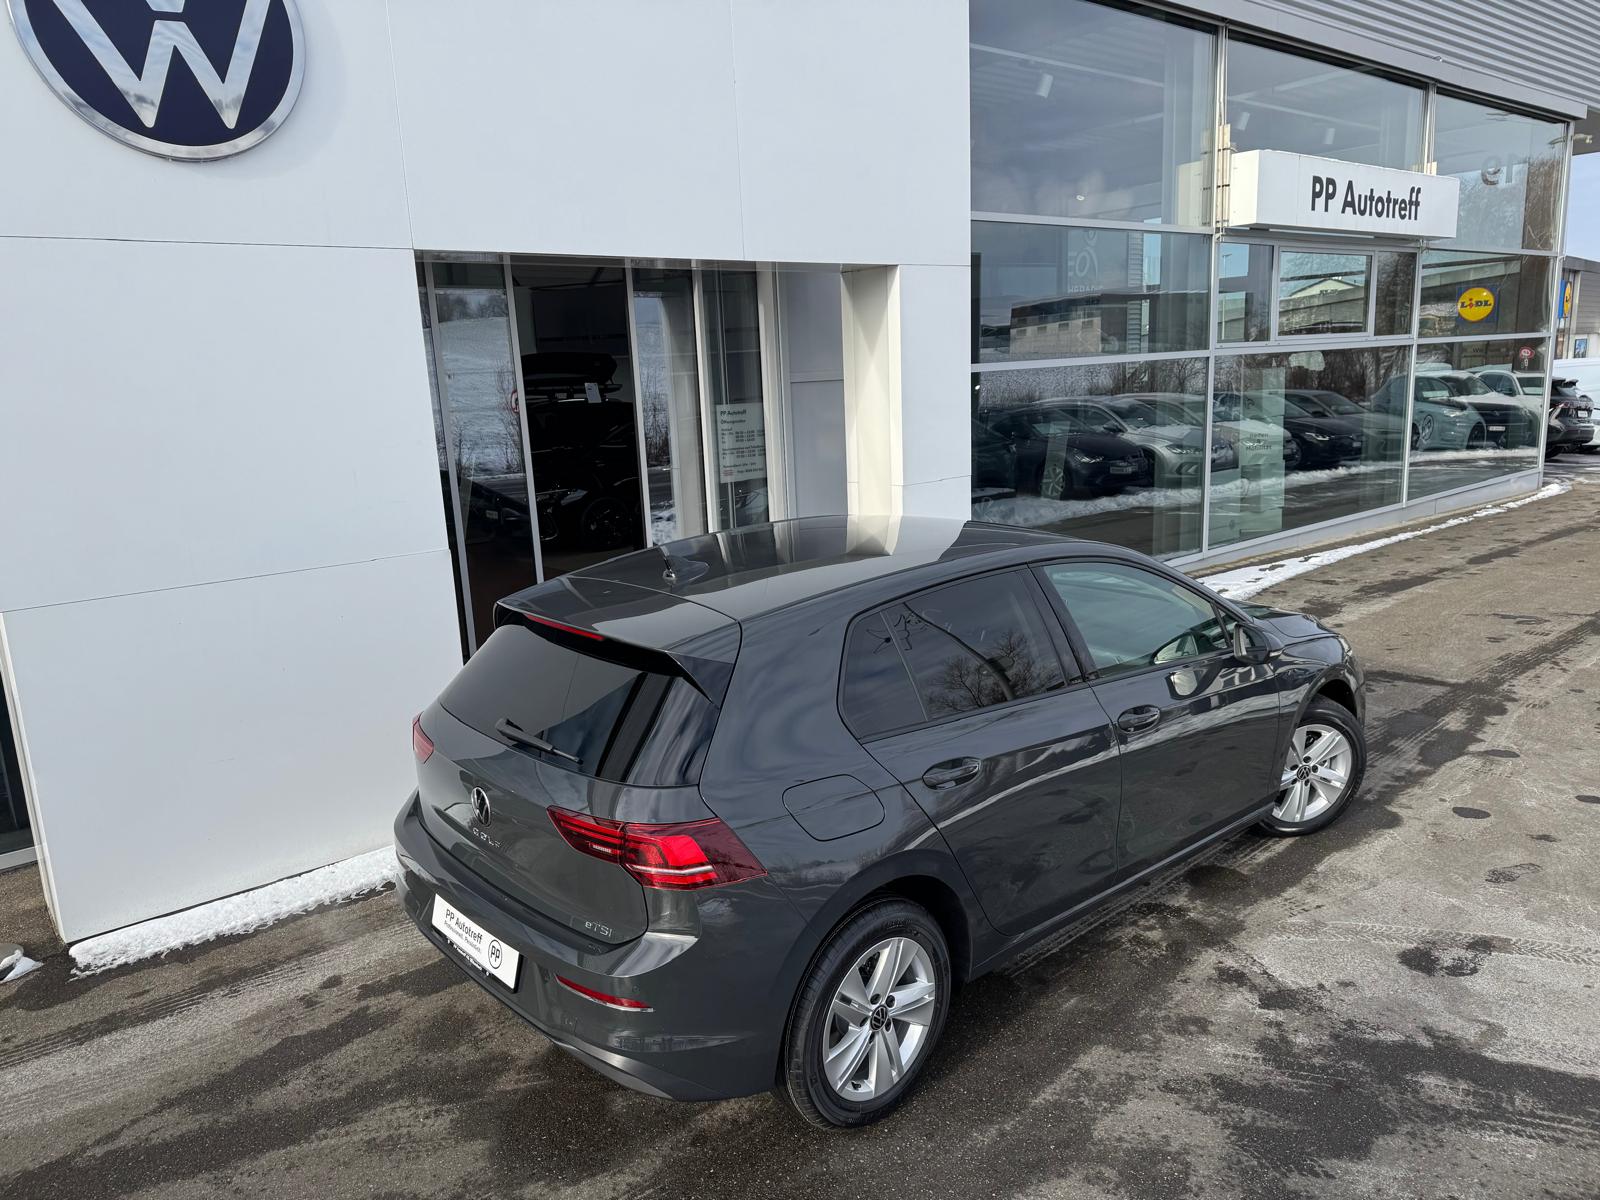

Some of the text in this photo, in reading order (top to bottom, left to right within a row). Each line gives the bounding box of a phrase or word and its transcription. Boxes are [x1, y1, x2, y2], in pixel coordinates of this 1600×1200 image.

[1311, 175, 1422, 221] PP Autotreff
[473, 827, 500, 848] GOLF
[445, 908, 483, 945] PP Autotreff
[585, 921, 613, 937] eTSI
[490, 945, 501, 963] PP
